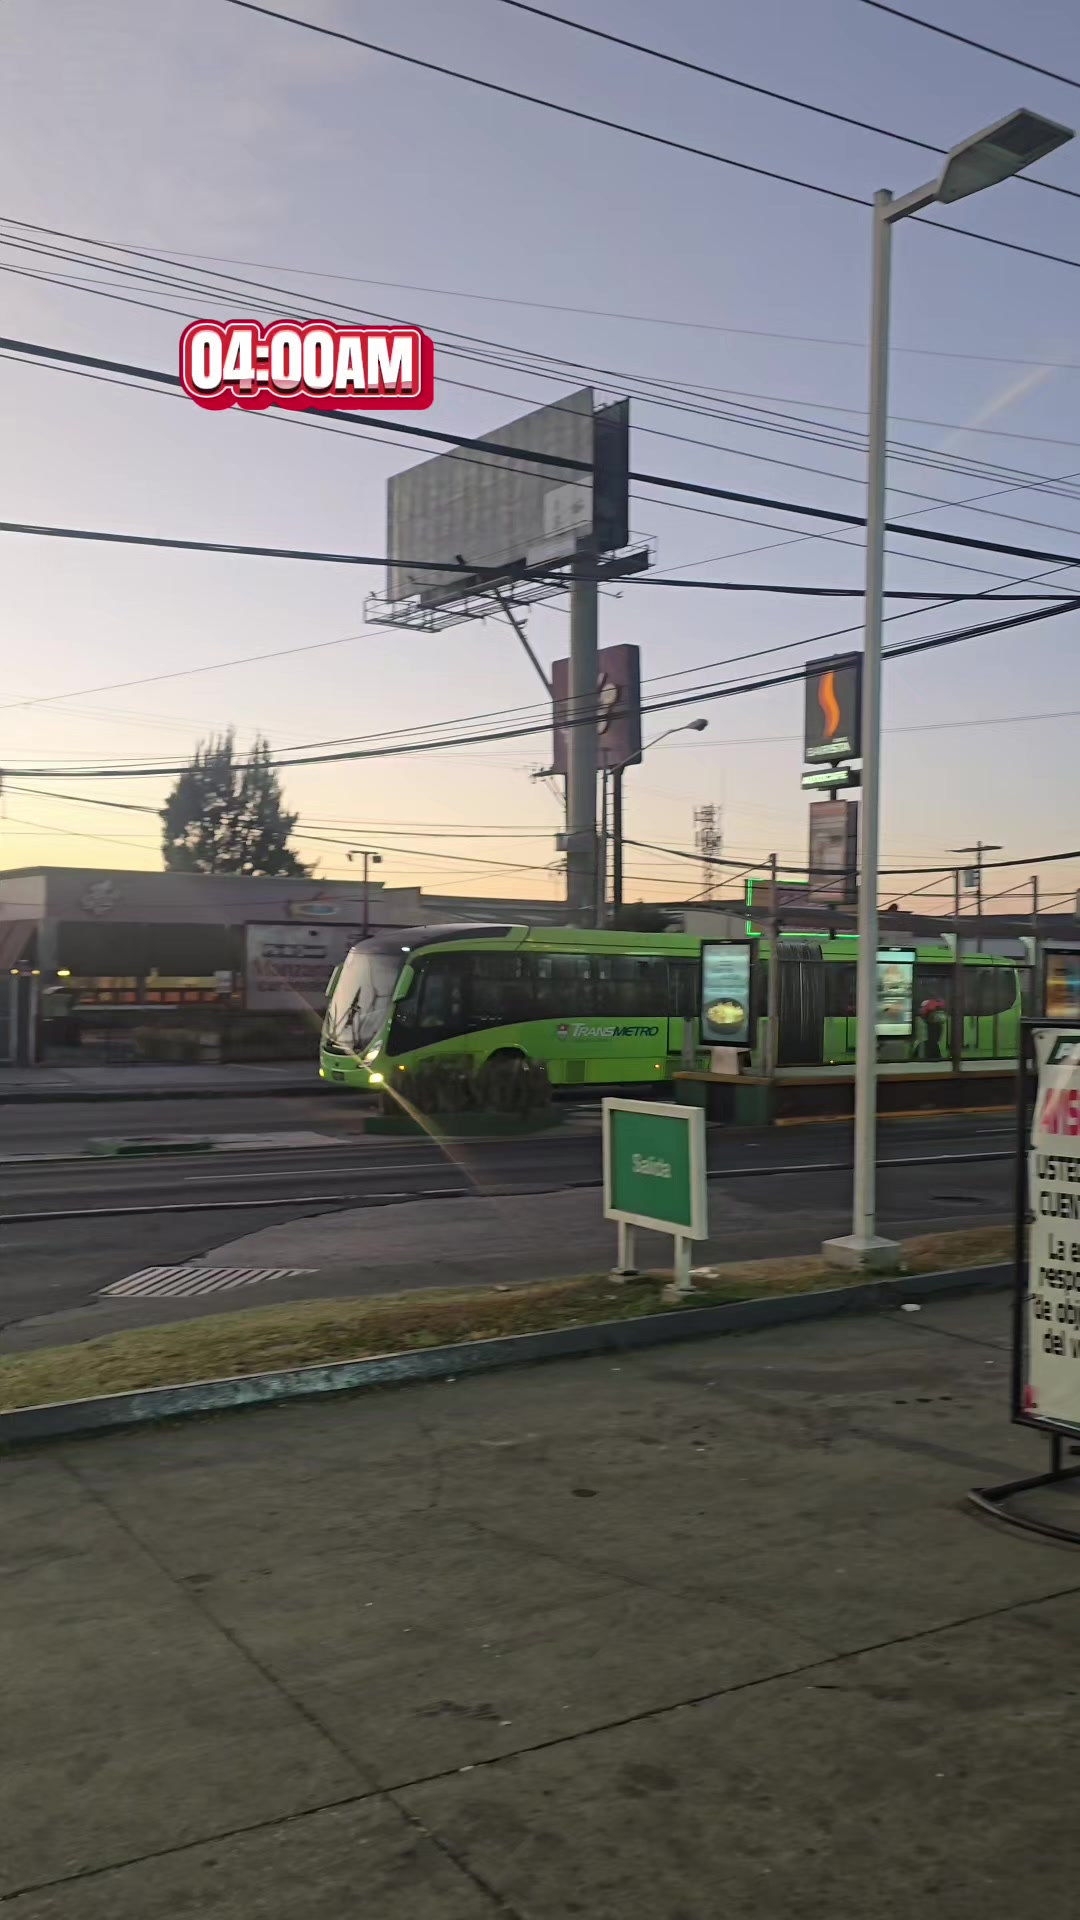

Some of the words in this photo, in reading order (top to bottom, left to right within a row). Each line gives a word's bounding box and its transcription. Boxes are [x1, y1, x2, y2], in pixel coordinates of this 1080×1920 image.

[632, 1153, 672, 1178] Salida
[1047, 1232, 1065, 1261] La
[1042, 1327, 1065, 1356] del
